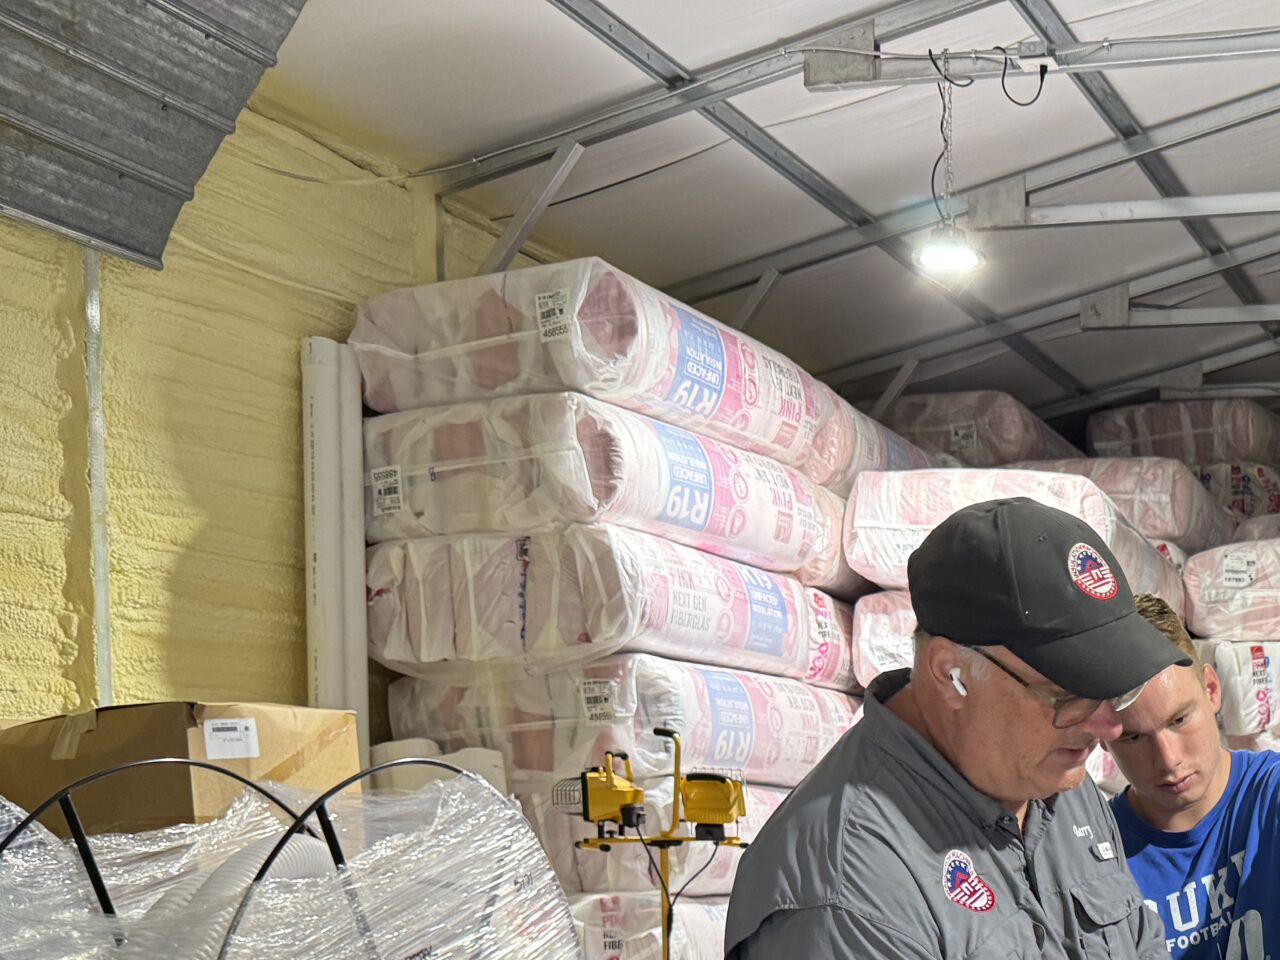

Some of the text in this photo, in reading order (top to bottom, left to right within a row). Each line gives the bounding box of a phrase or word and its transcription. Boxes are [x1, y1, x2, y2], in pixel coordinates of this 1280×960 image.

[686, 361, 720, 386] UNFACED
[674, 380, 718, 416] R19
[673, 465, 707, 486] UNFACED
[667, 485, 710, 525] R19
[670, 611, 711, 632] FIBERGLAS
[714, 729, 751, 763] R19
